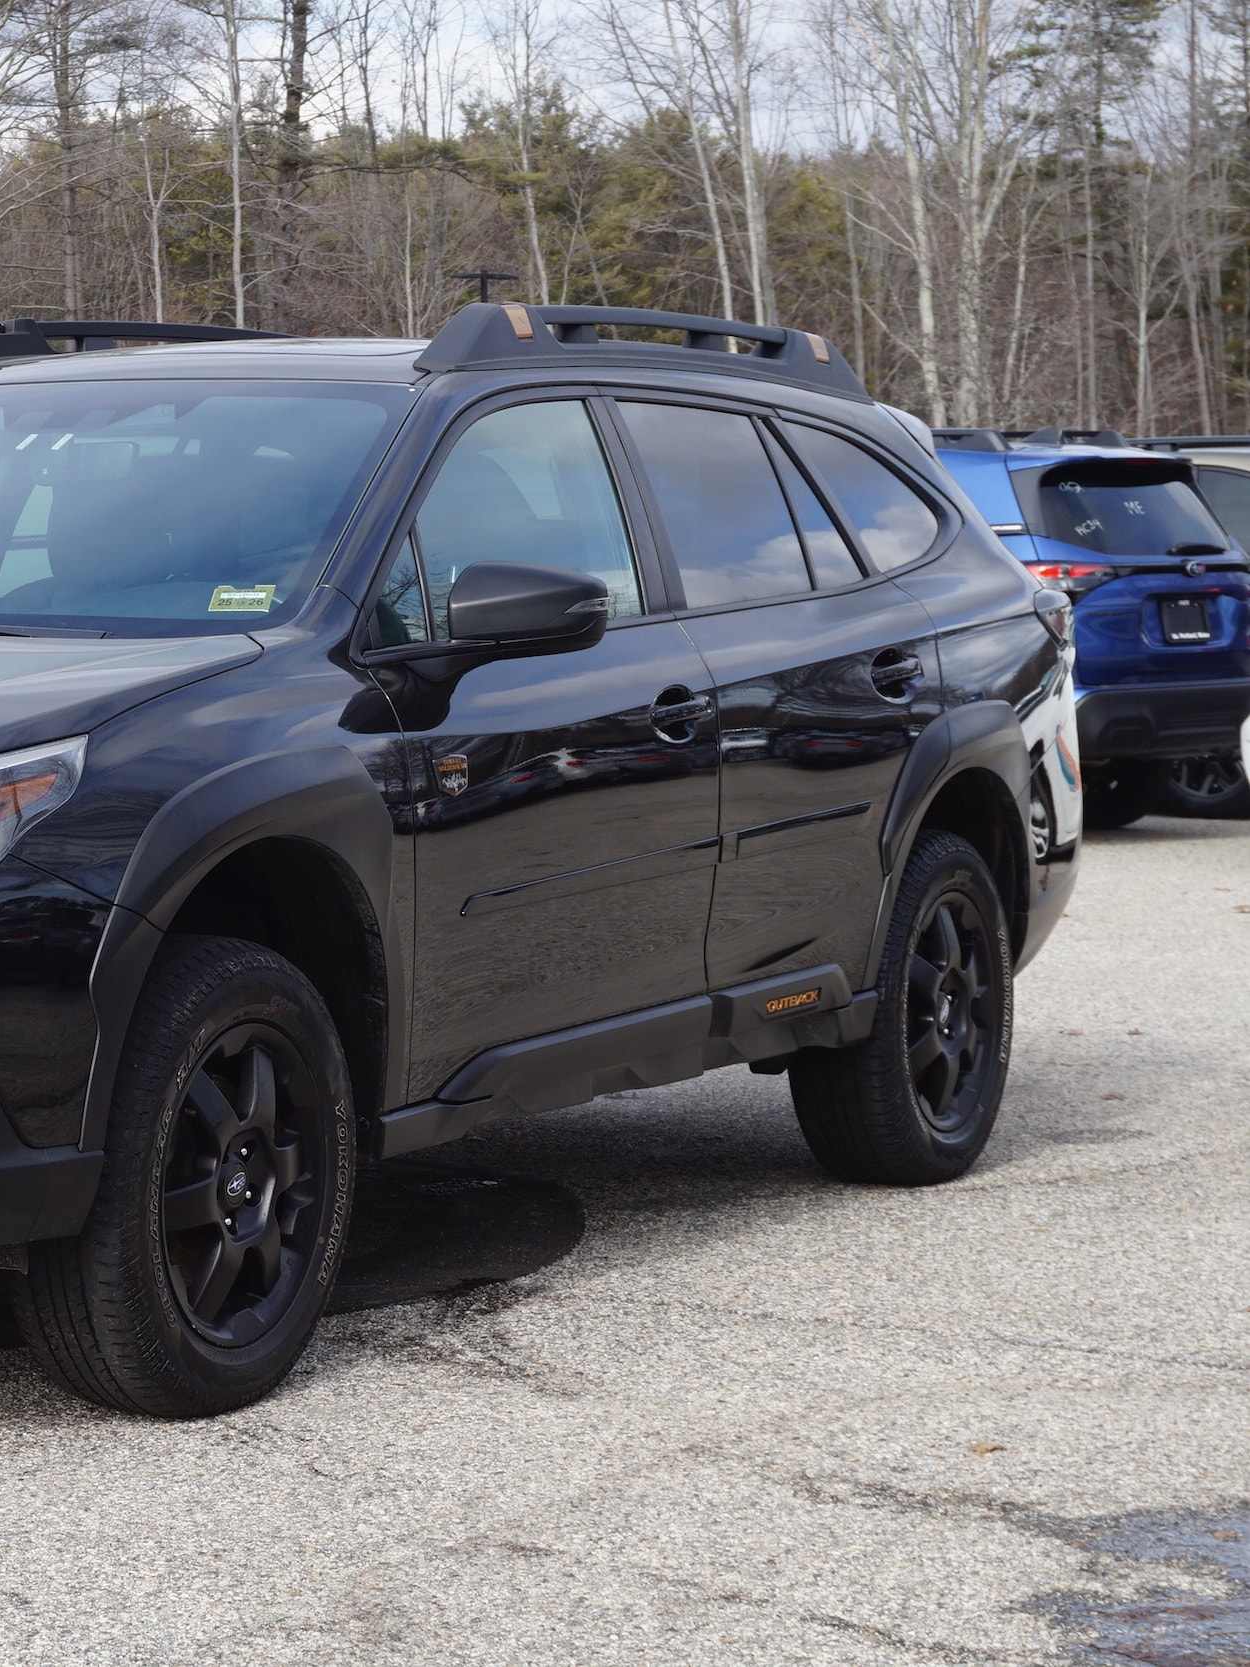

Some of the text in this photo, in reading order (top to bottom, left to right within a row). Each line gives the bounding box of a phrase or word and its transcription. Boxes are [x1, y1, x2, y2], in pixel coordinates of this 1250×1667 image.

[218, 598, 233, 606] 25
[249, 598, 264, 606] 26
[766, 990, 819, 1013] OUTBACK
[317, 1098, 350, 1287] YOKOHAMA
